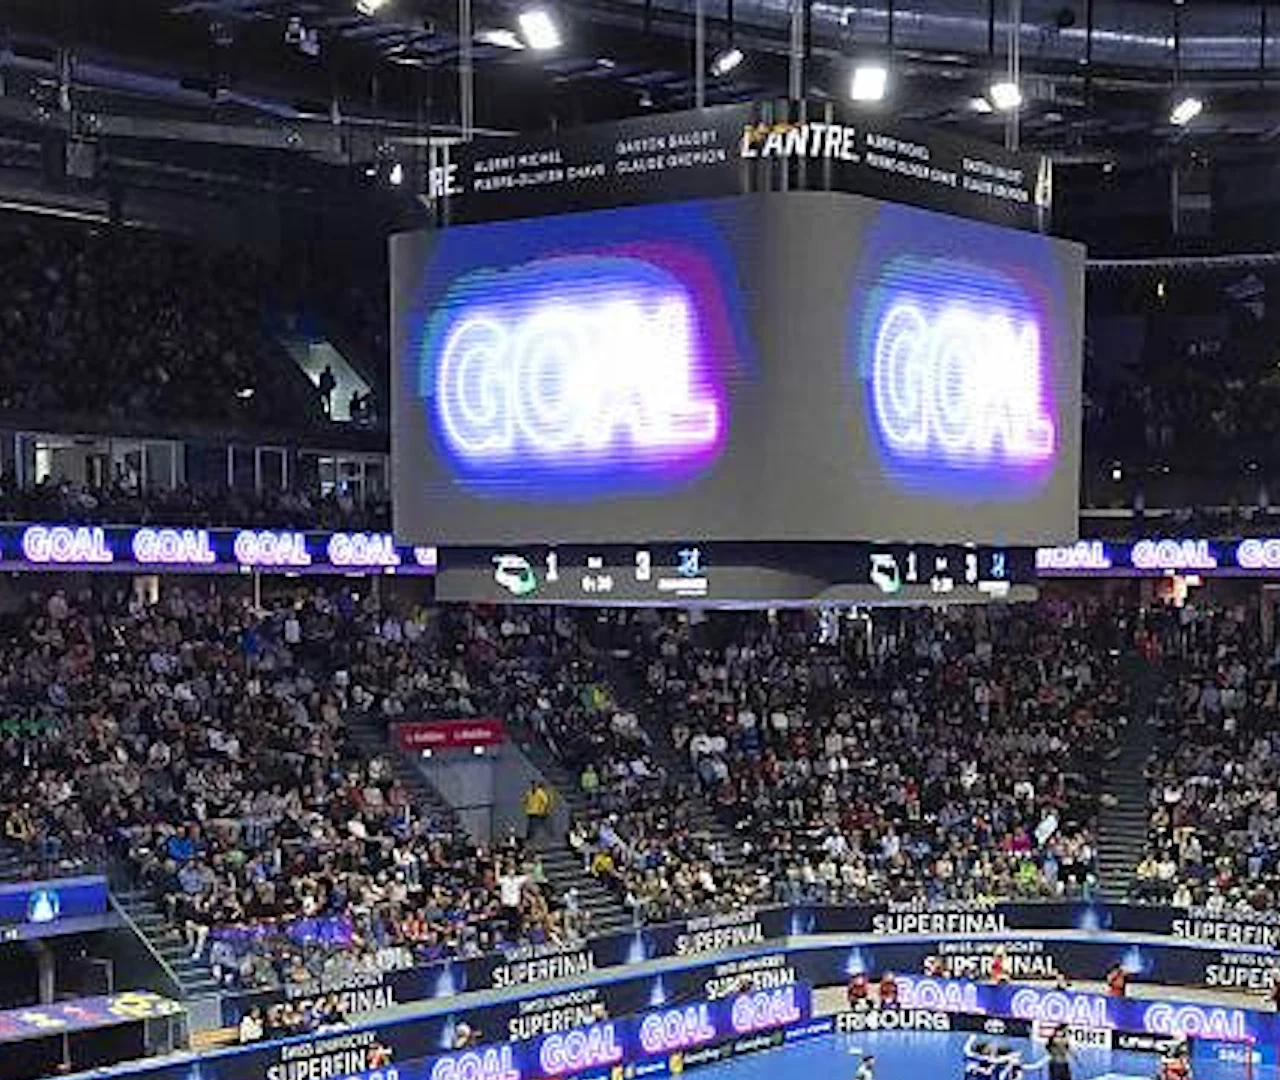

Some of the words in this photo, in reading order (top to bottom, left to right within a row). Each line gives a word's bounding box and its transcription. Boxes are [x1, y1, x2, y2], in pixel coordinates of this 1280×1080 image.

[438, 296, 720, 457] GOAL
[873, 304, 1055, 459] GOAL
[23, 526, 114, 563] GOAL
[132, 528, 216, 564] GOAL
[234, 531, 312, 567] GOAL
[327, 532, 401, 567] GOAL
[1132, 539, 1217, 569] GOAL
[545, 552, 558, 581] 1
[634, 551, 651, 580] 3
[872, 913, 1008, 935] SUPERFINAL
[1172, 919, 1277, 947] SUPERFIN
[491, 953, 596, 989] SUPERFINAL
[508, 1004, 595, 1042] SUPERFIN
[1011, 991, 1118, 1031] GOAL
[1144, 1004, 1257, 1045] GOAL
[639, 1005, 717, 1054] GOAL
[540, 1025, 623, 1077] GOAL
